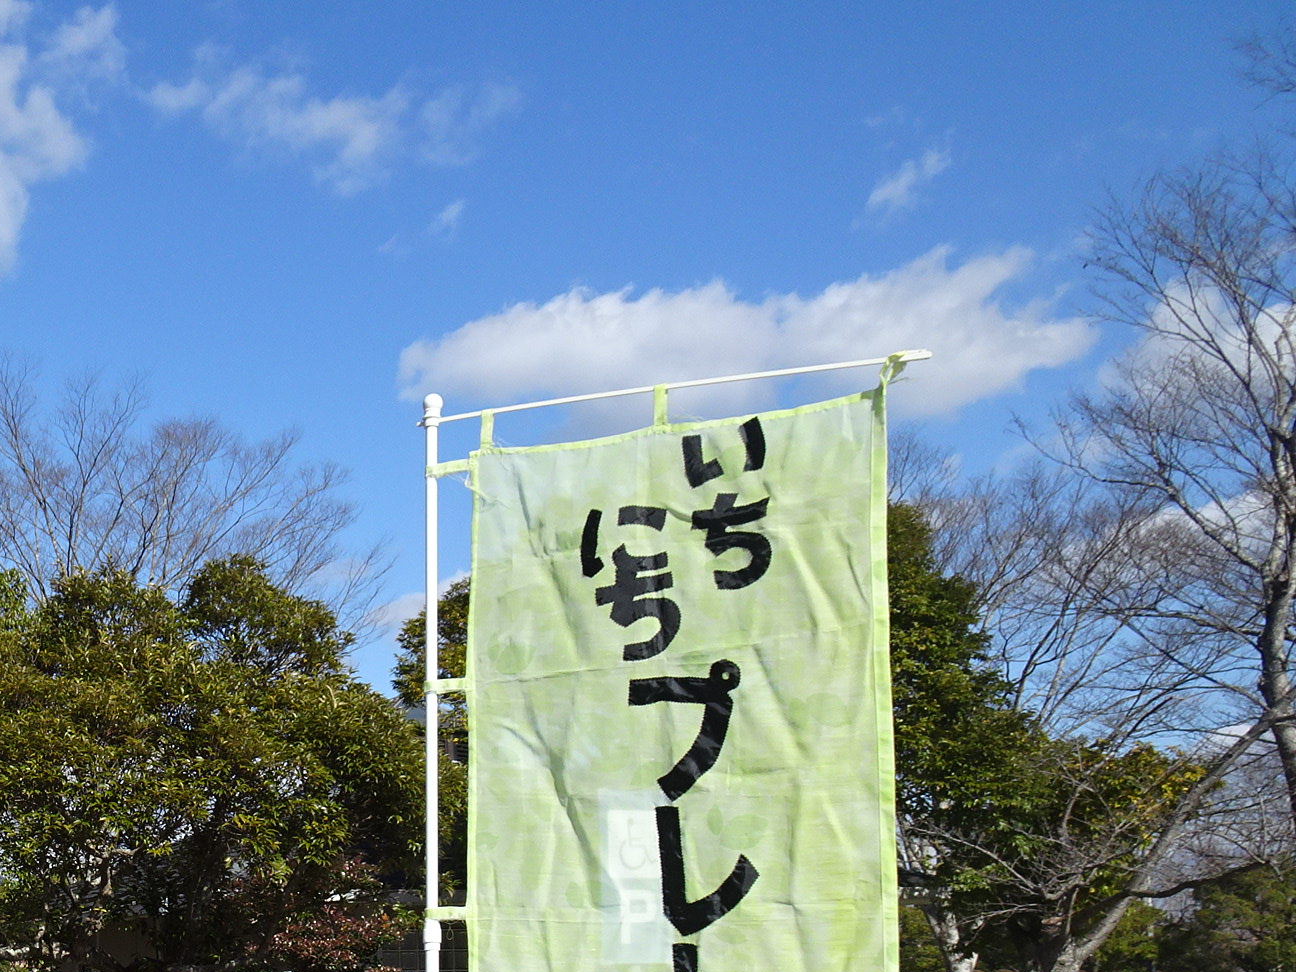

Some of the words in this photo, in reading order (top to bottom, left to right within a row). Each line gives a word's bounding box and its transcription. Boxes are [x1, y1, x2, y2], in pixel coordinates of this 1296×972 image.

[681, 416, 772, 590] いち
[580, 504, 682, 662] にち
[620, 889, 656, 944] P
